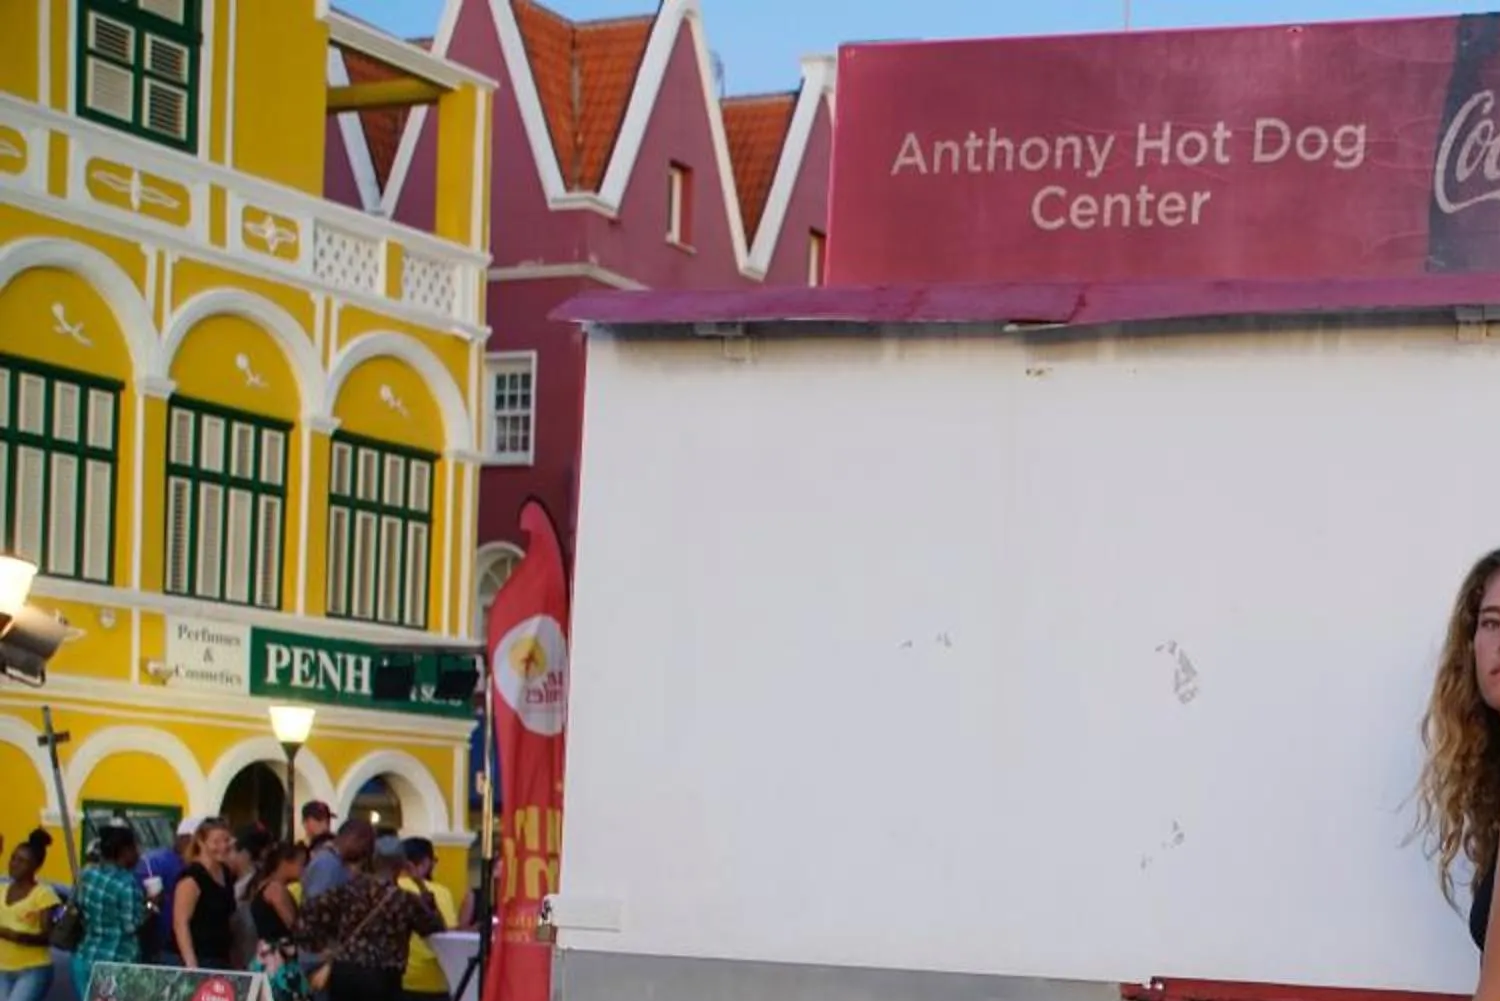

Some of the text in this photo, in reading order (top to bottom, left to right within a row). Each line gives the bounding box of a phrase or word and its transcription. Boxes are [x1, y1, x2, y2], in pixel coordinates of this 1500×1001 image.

[890, 117, 1367, 179] Anthony Hot Dog
[1030, 184, 1212, 231] Center
[177, 623, 241, 647] Perfumes
[174, 663, 243, 687] Cosmetics
[264, 643, 388, 695] PENH
